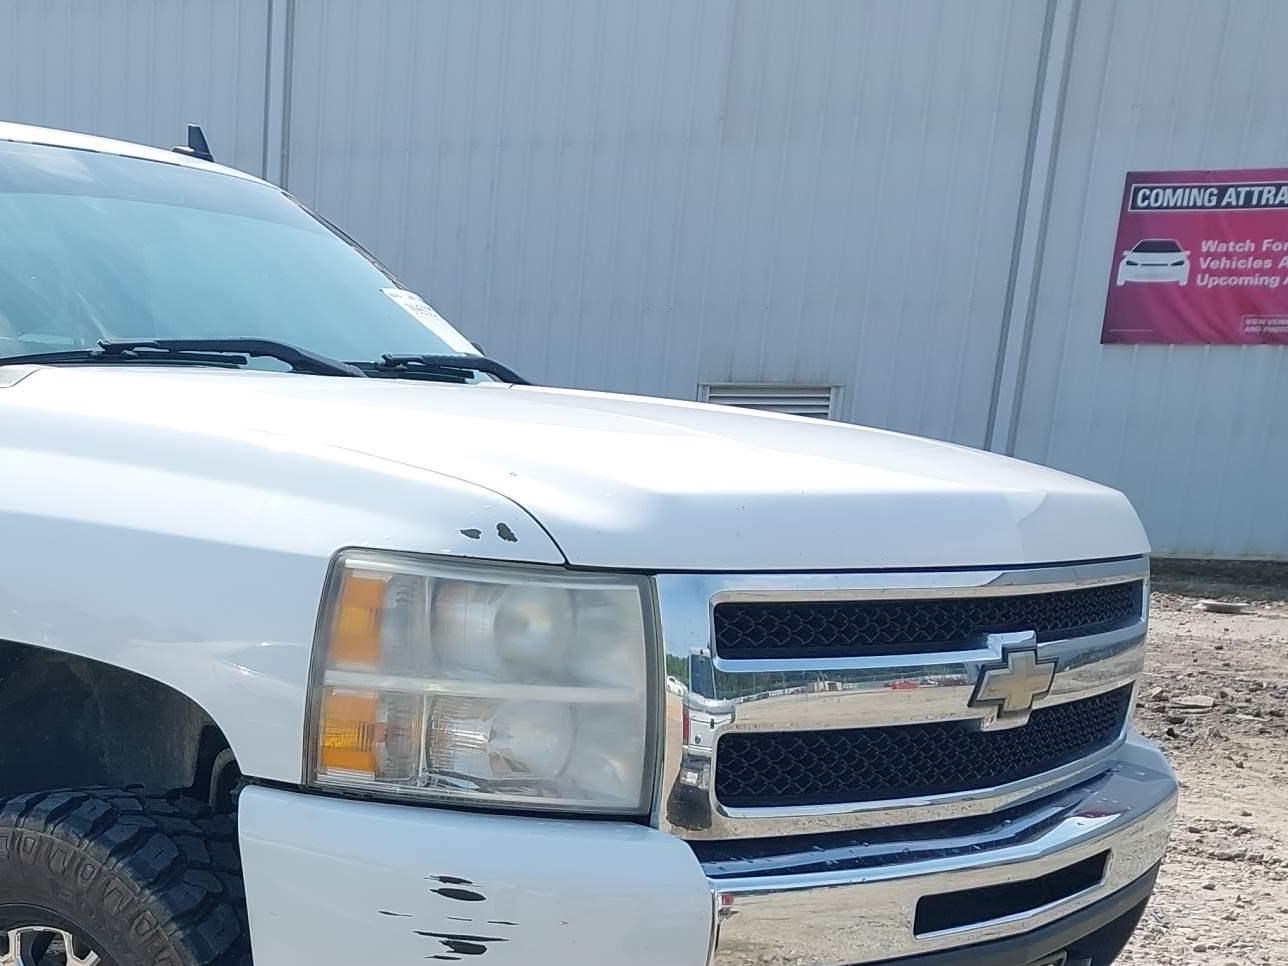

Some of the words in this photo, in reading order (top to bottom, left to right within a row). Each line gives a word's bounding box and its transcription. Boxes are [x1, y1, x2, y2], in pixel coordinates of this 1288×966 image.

[1136, 187, 1219, 208] COMING
[1221, 186, 1288, 207] ATTRA
[1201, 240, 1255, 253] Watch
[1199, 257, 1273, 270] Vehicles
[1196, 274, 1280, 288] Upcoming
